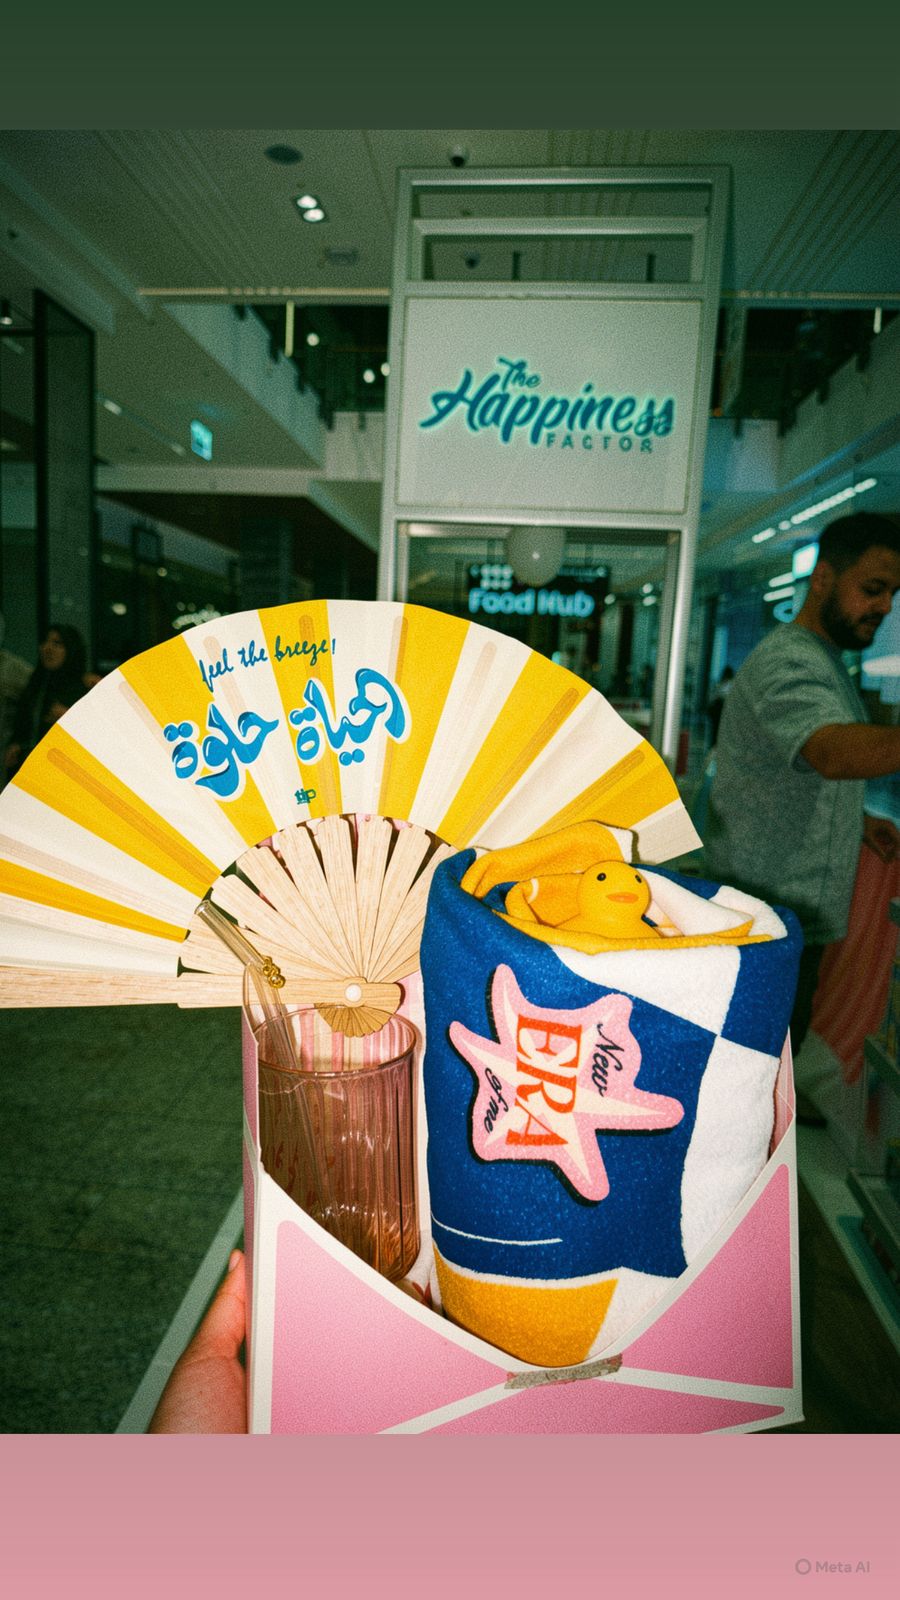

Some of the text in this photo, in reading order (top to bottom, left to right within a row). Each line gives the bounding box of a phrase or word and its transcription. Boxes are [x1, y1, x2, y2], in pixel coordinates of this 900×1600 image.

[419, 369, 674, 444] Happiness
[498, 356, 541, 391] The
[546, 432, 653, 454] FACTOR
[468, 587, 595, 618] Food Hub
[199, 634, 336, 693] feel the breeze!
[163, 703, 280, 797] حلوة
[505, 1014, 582, 1147] ERA
[591, 1022, 625, 1097] New
[484, 1067, 509, 1134] of me
